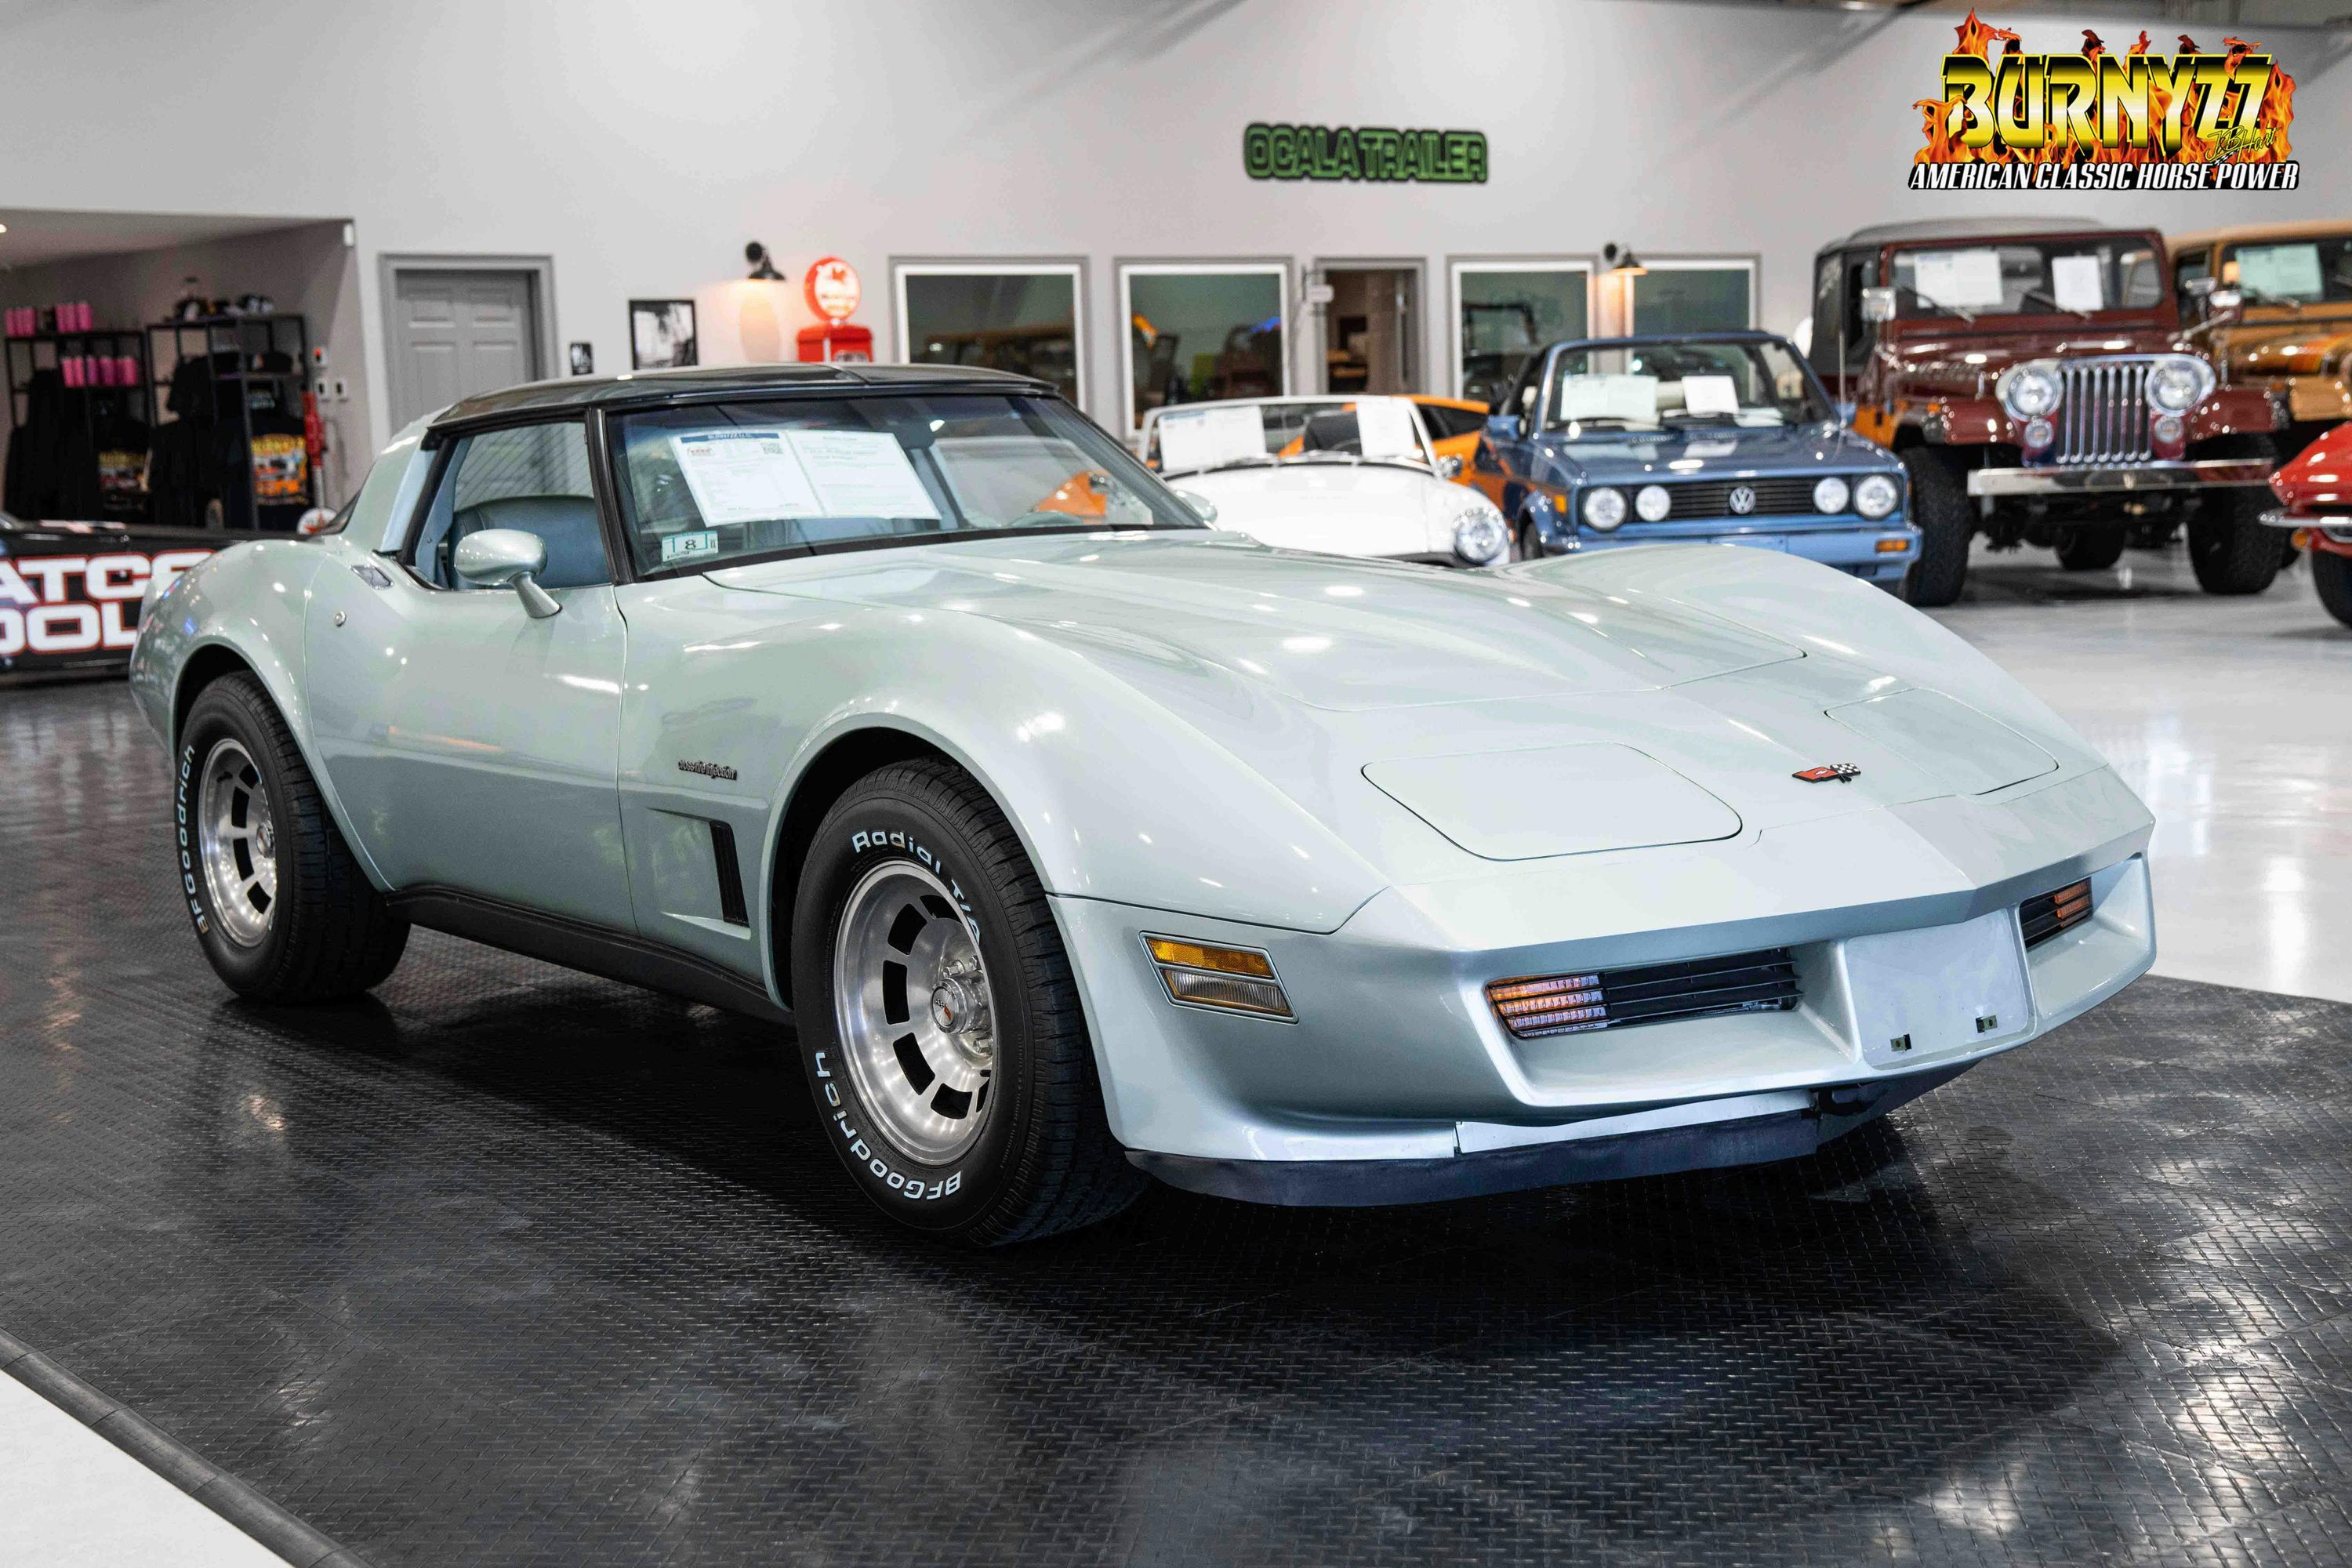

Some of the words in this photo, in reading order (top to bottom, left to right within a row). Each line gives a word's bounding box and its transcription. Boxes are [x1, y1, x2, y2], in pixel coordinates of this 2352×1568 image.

[1245, 124, 1361, 180] OCALA
[1357, 128, 1487, 182] TRAILER
[851, 829, 942, 874] Radial
